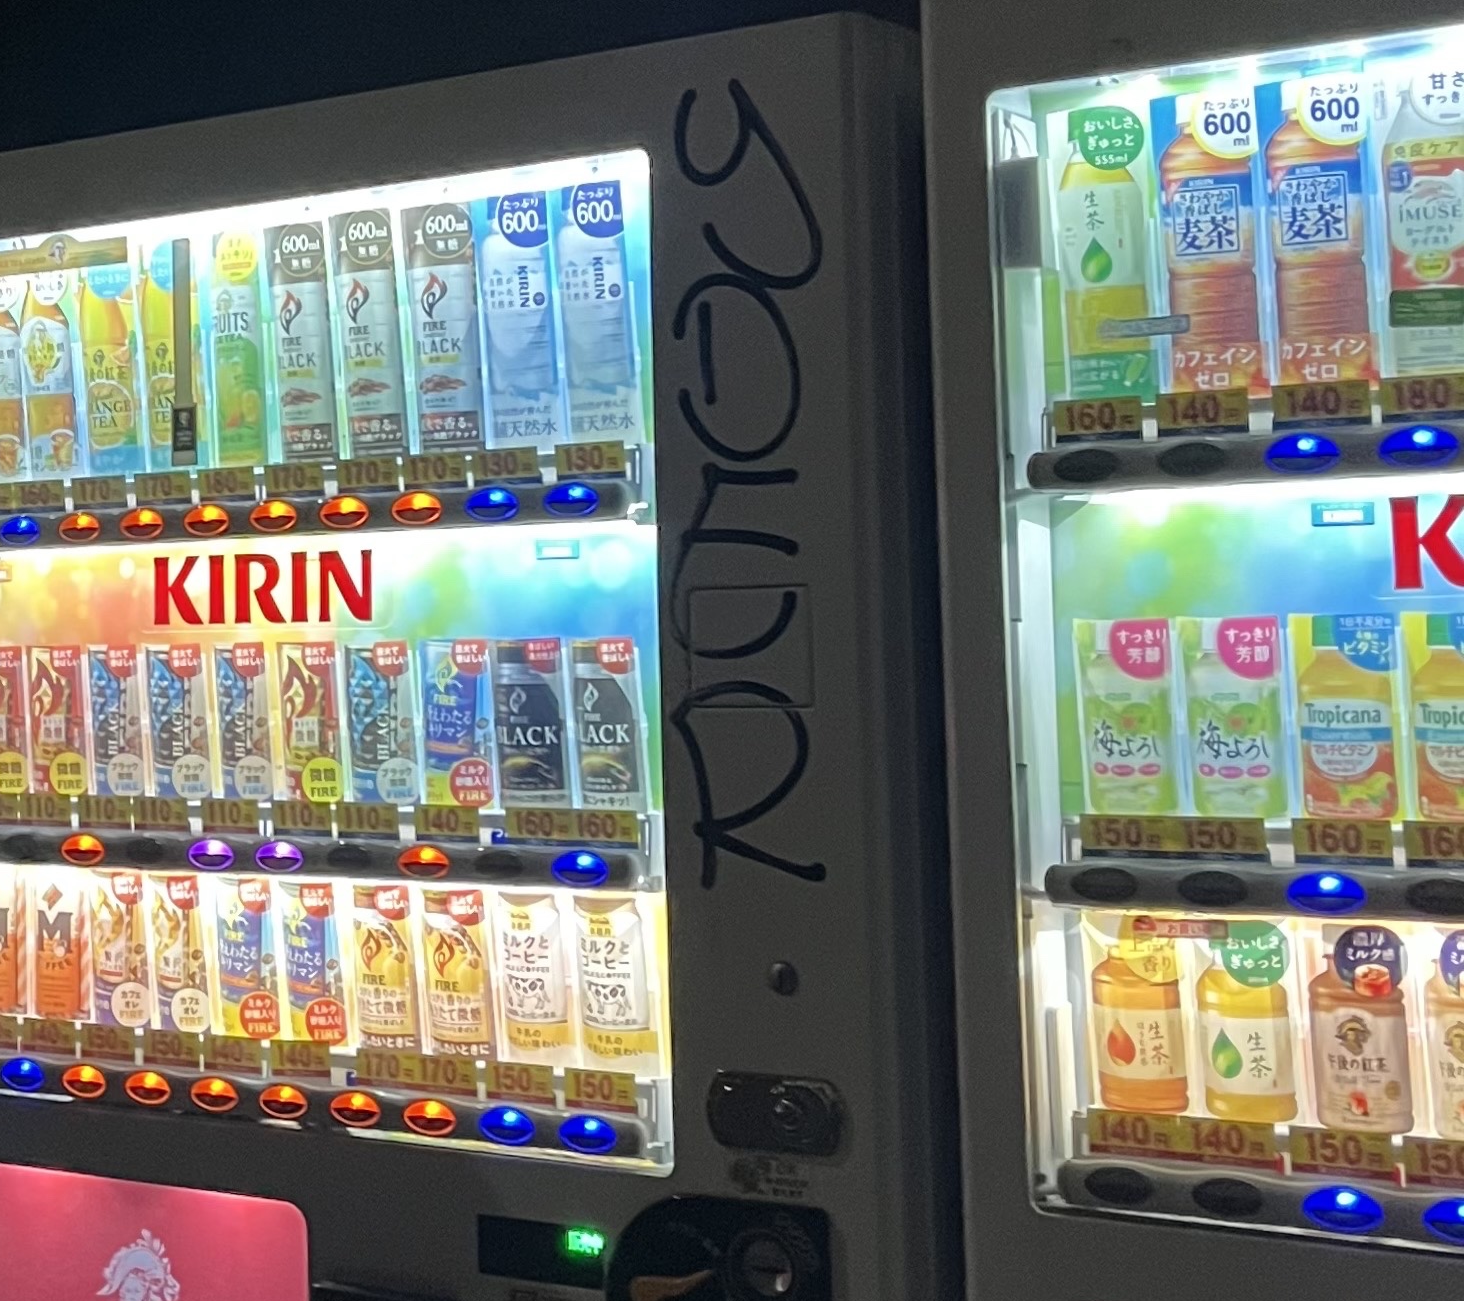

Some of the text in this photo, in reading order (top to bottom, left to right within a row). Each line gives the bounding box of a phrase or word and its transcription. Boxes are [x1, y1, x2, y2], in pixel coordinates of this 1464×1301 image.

[1310, 83, 1358, 98] たっぷり
[1203, 96, 1251, 111] たっぷり
[1310, 97, 1360, 122] 600
[1203, 110, 1252, 135] 600
[1341, 122, 1358, 133] ml
[1086, 134, 1134, 150] ぎゅっと
[1233, 135, 1251, 147] ml
[576, 186, 614, 200] たっぷり
[503, 197, 539, 211] たっぷり
[1083, 191, 1105, 230] 生茶
[348, 221, 388, 240] 600ml
[425, 214, 469, 234] 600ml
[1284, 204, 1343, 241] 麦茶
[1176, 215, 1235, 252] 麦茶
[281, 234, 321, 252] 600ml
[517, 265, 530, 308] KIRIN
[592, 256, 606, 300] KIRIN
[1174, 347, 1256, 369] カフェイン
[1282, 339, 1367, 360] カフェイン
[1196, 369, 1230, 389] ゼロ
[1303, 361, 1337, 381] ゼロ
[92, 415, 119, 429] TEA
[153, 549, 373, 626] KIRIN
[1117, 628, 1167, 646] すっきり
[1224, 627, 1277, 644] すっきり
[1304, 702, 1382, 728] Tropicana
[57, 778, 83, 790] FIRE
[310, 785, 337, 798] FIRE
[503, 931, 549, 949] ミルクと
[580, 936, 630, 955] ミルクと
[504, 950, 549, 964] コーヒー
[582, 954, 630, 970] コーヒー
[1230, 954, 1282, 969] ぎゅっと
[363, 973, 386, 986] FIRE
[436, 979, 459, 992] FIRE
[248, 1020, 276, 1034] FIRE
[1148, 1021, 1170, 1065] 生茶
[1246, 1031, 1273, 1079] 生茶
